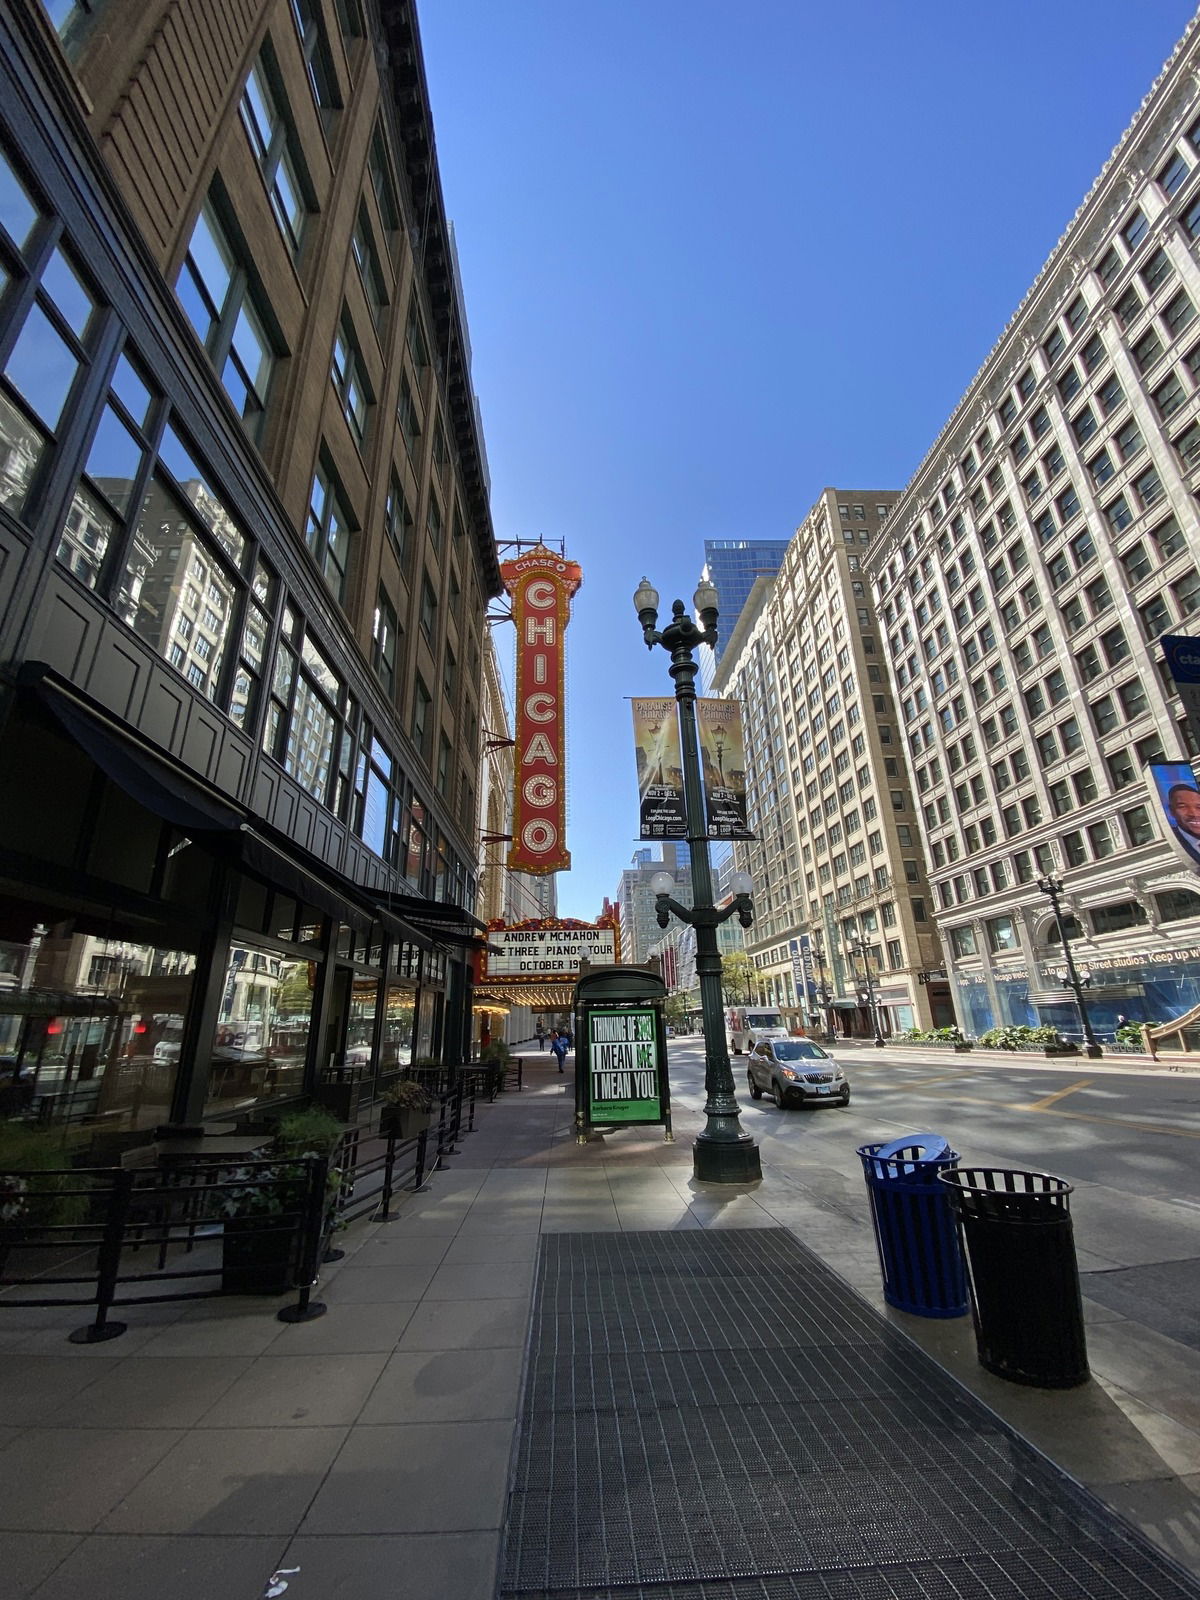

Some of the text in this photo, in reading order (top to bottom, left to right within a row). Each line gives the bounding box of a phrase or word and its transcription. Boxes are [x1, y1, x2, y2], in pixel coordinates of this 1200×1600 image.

[515, 559, 555, 571] CHASE
[522, 581, 558, 854] CHICAGO
[504, 931, 600, 942] ANDREW MCMAHON
[508, 946, 540, 956] THREE
[588, 945, 613, 955] TOUR
[1088, 960, 1112, 970] Street
[1114, 956, 1148, 967] studios.
[1148, 952, 1173, 964] Keep
[1174, 950, 1190, 961] up
[520, 960, 564, 971] OCTOBER
[593, 1015, 626, 1042] THINKING
[628, 1015, 637, 1041] OF
[594, 1045, 598, 1070] I
[601, 1044, 633, 1070] MEAN
[594, 1071, 655, 1100] I MEAN YOU
